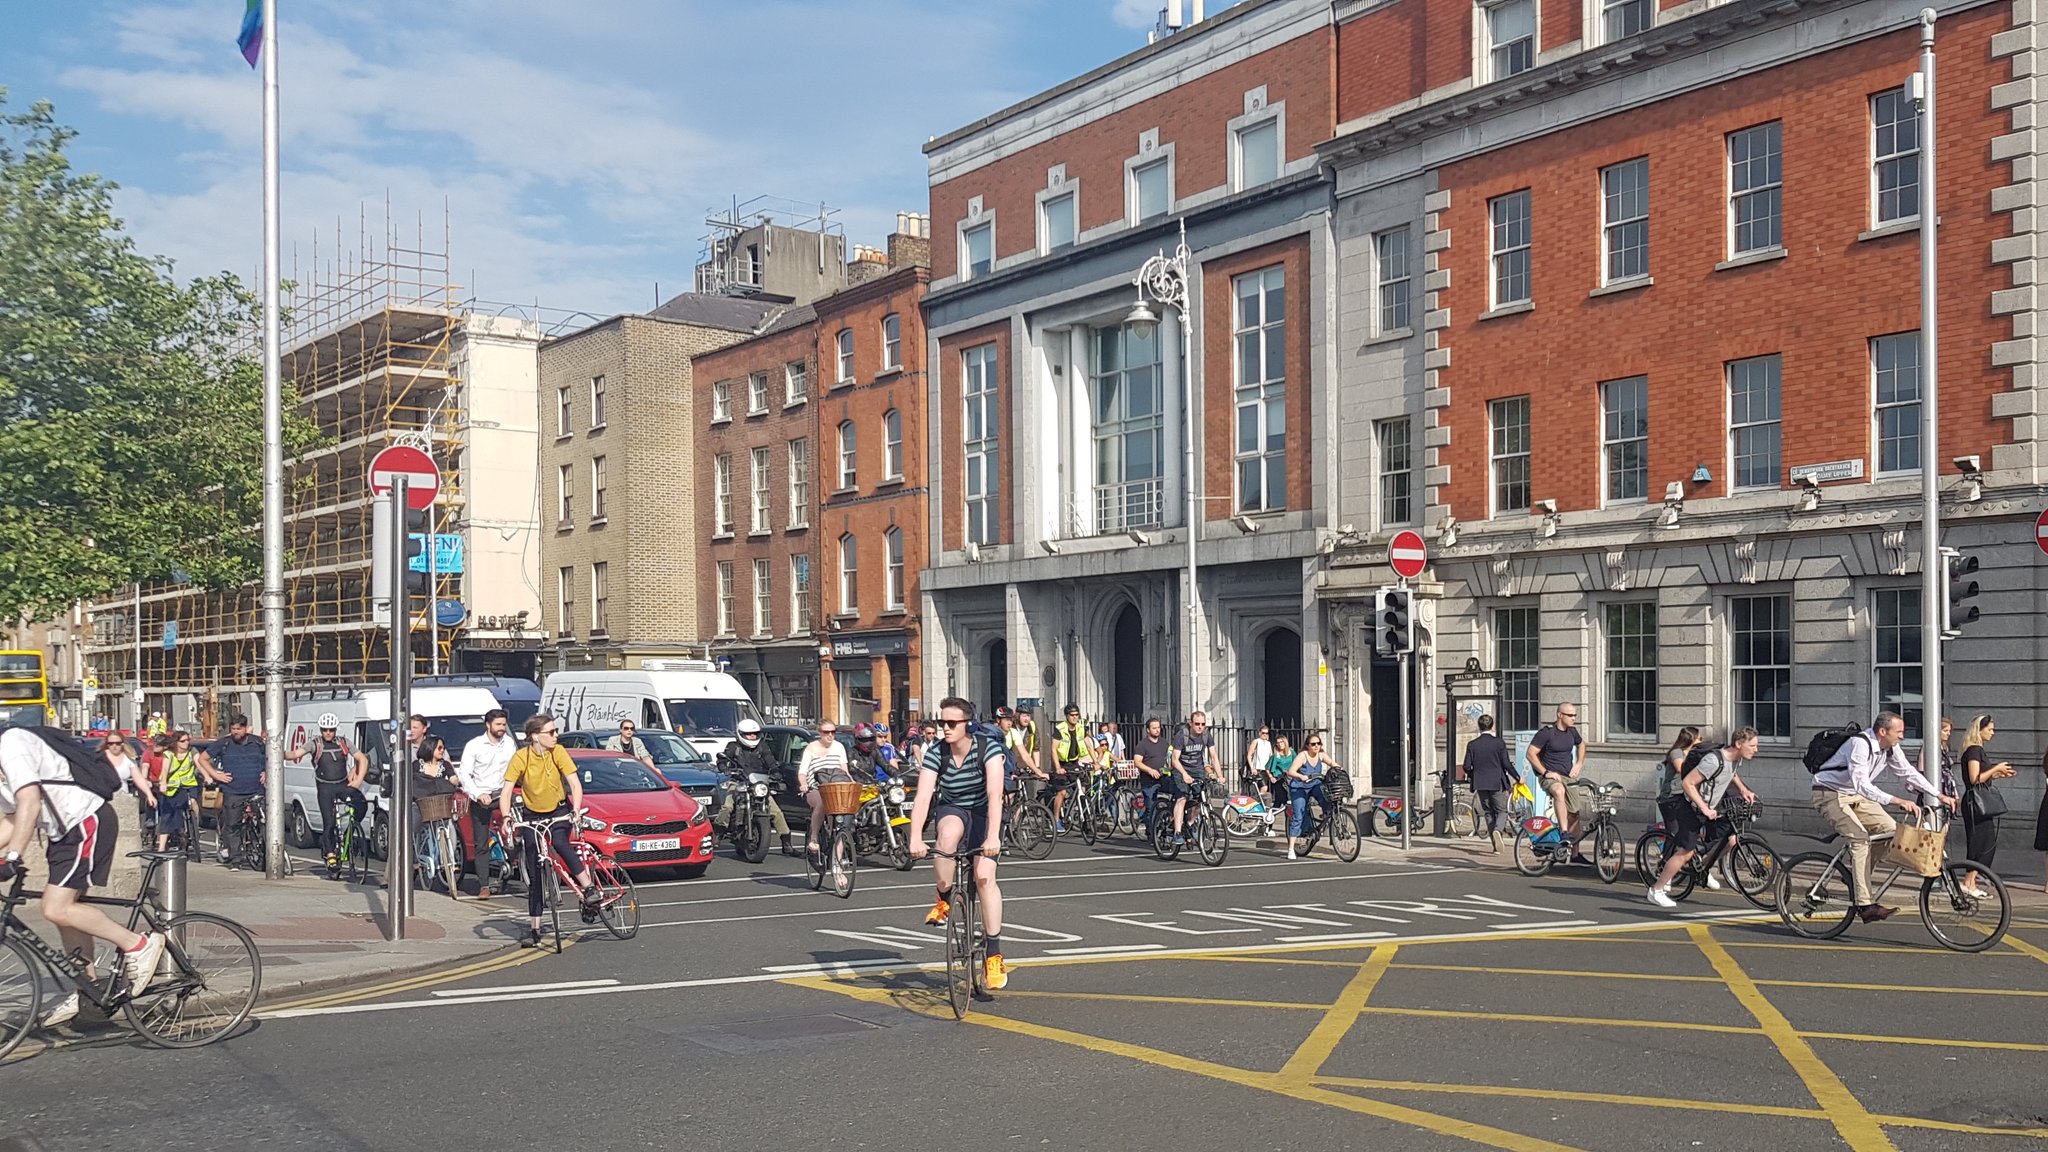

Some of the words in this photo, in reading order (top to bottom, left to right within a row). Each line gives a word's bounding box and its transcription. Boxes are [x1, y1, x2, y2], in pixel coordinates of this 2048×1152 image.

[834, 642, 853, 655] FMB
[773, 705, 799, 718] CREATE
[639, 840, 677, 850] 161-KE-4360
[814, 922, 1084, 950] NO
[1089, 895, 1575, 935] ENTRY
